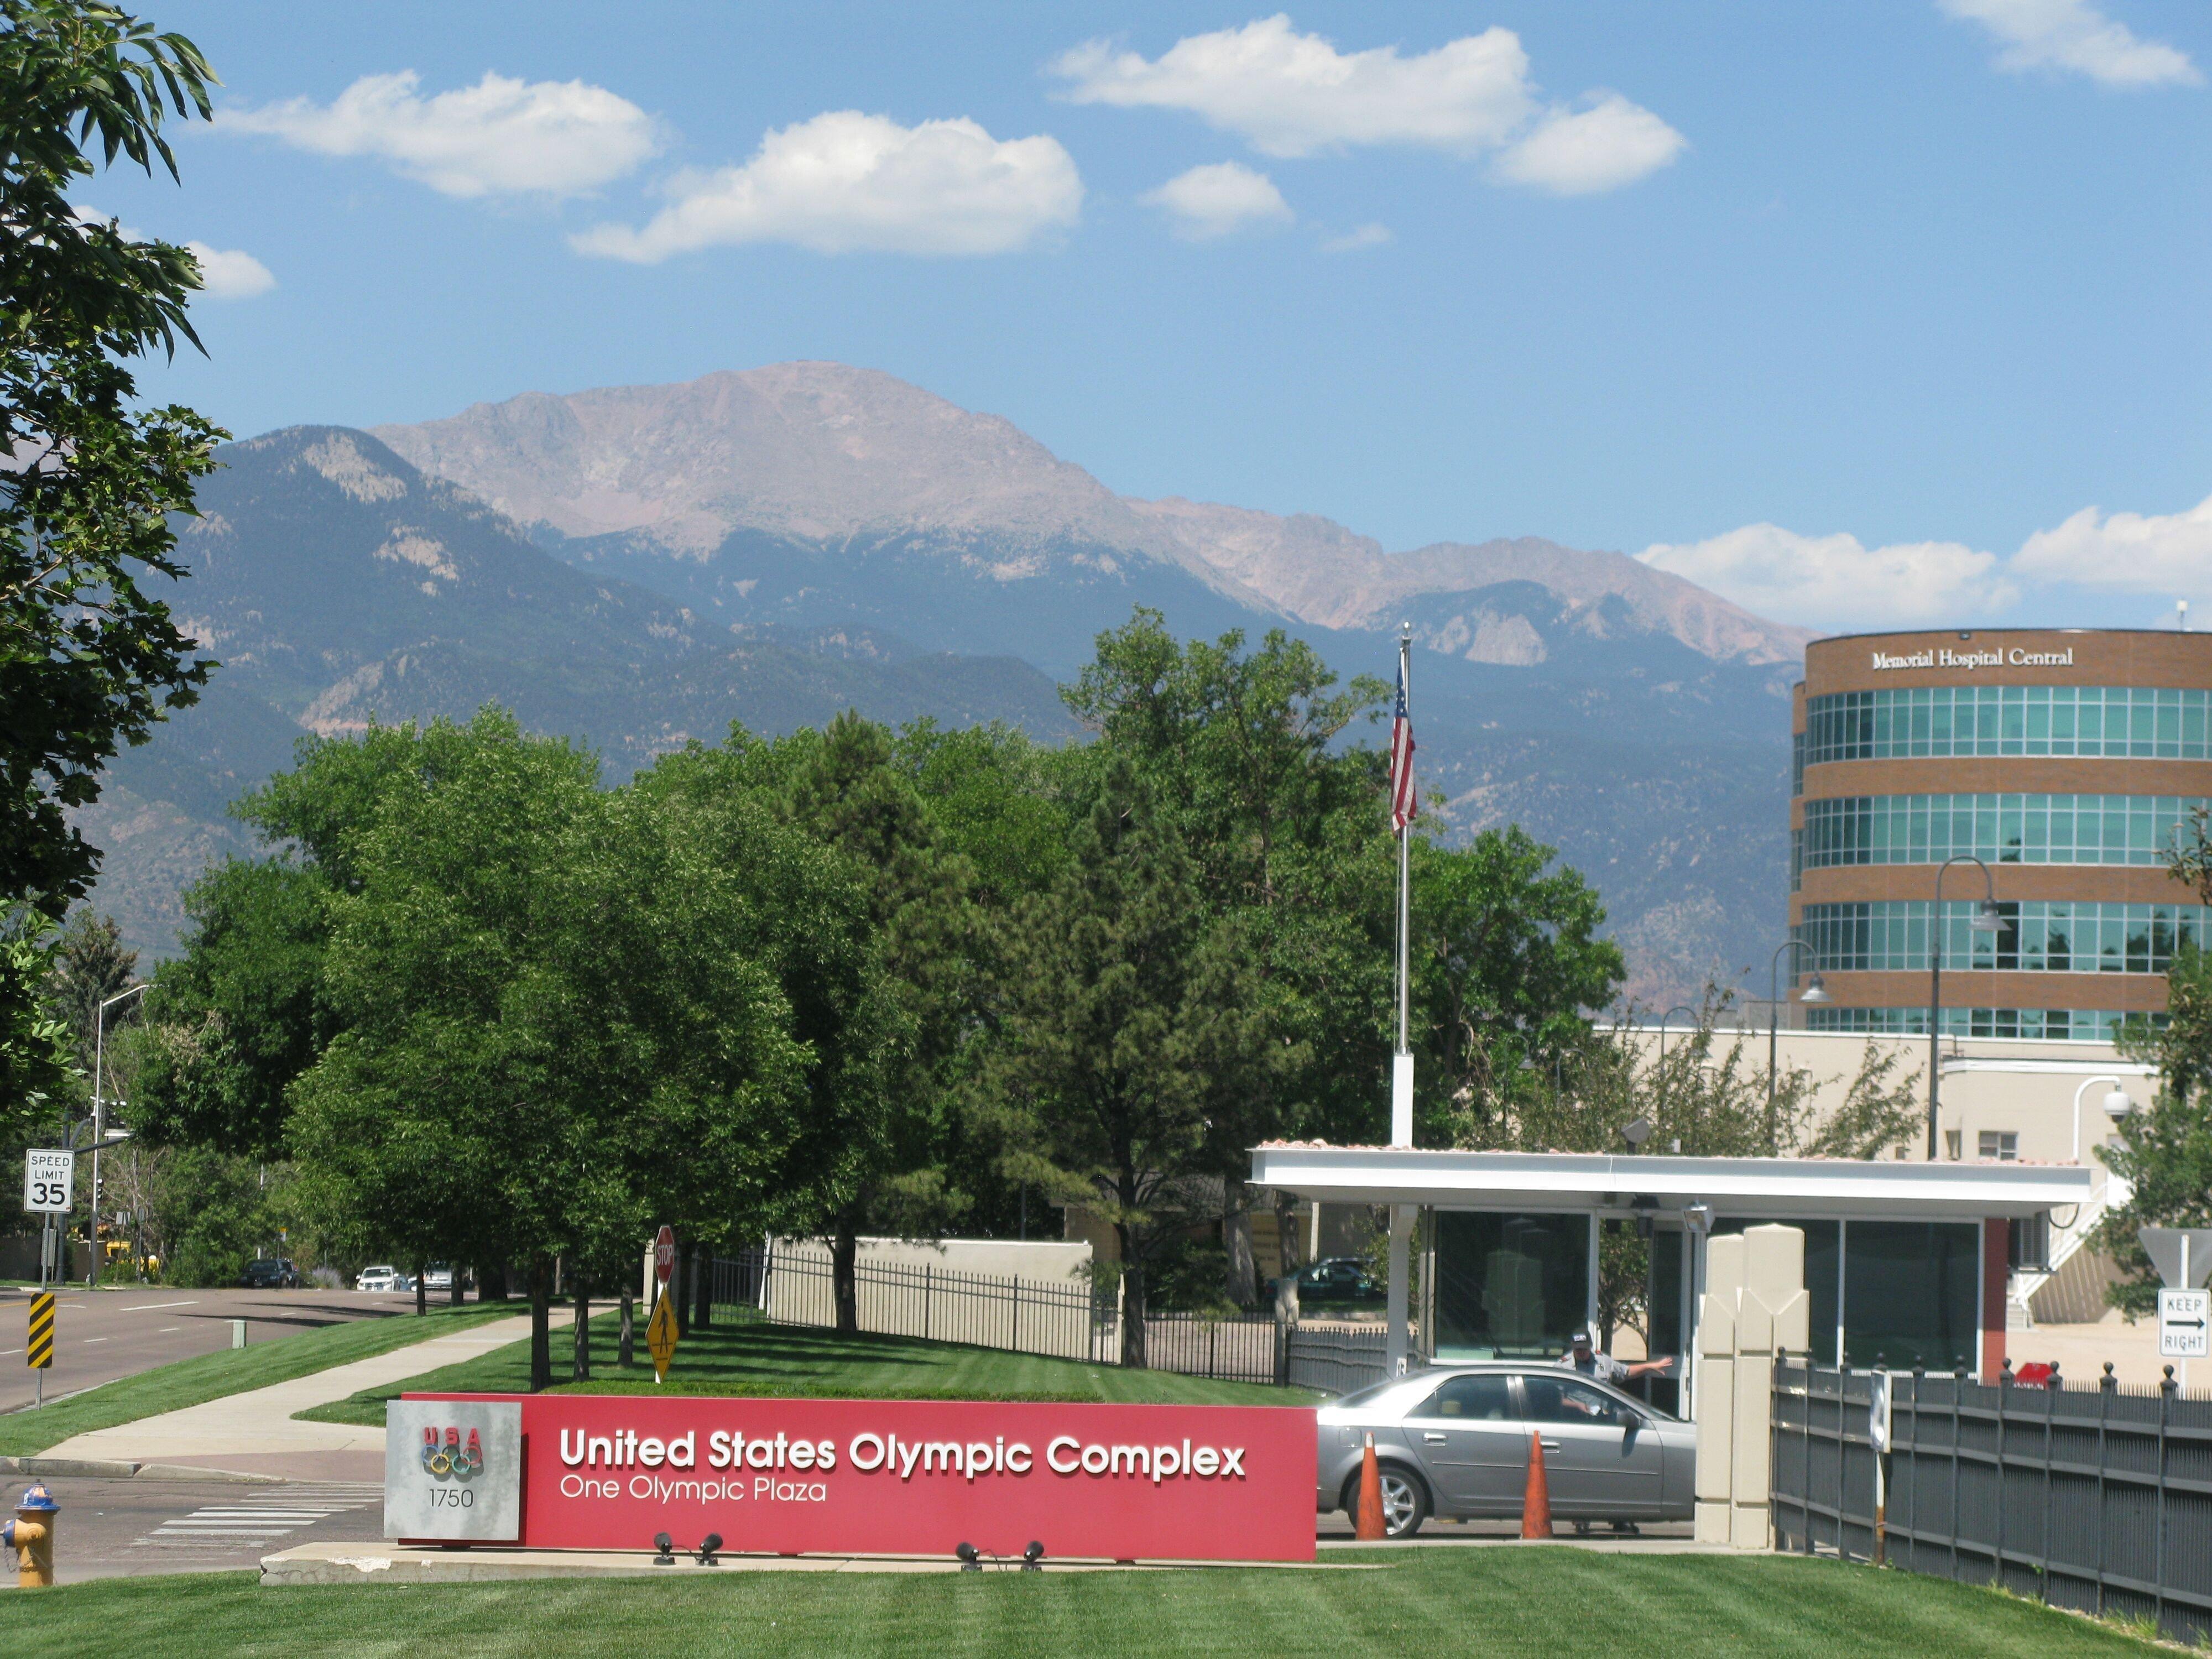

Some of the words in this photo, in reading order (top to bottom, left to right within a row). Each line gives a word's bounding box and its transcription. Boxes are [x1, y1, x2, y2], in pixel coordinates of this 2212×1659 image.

[1872, 649, 1934, 670] Memorial
[1939, 648, 2004, 670] Hospital
[2008, 648, 2074, 666] Central
[32, 1156, 70, 1166] SPEED
[35, 1170, 65, 1180] LIMIT
[32, 1182, 65, 1205] 35
[657, 1245, 673, 1266] STOP
[2167, 1297, 2203, 1312] KEEP
[2164, 1334, 2203, 1350] RIGHT
[424, 1426, 481, 1445] USA
[560, 1429, 695, 1467] United
[708, 1431, 836, 1469] States
[848, 1433, 1033, 1479] Olympic
[1046, 1436, 1246, 1483] Complex
[429, 1489, 474, 1508] 1750
[560, 1474, 620, 1498] One
[629, 1475, 744, 1505] Olympic
[754, 1477, 827, 1502] Plaza
